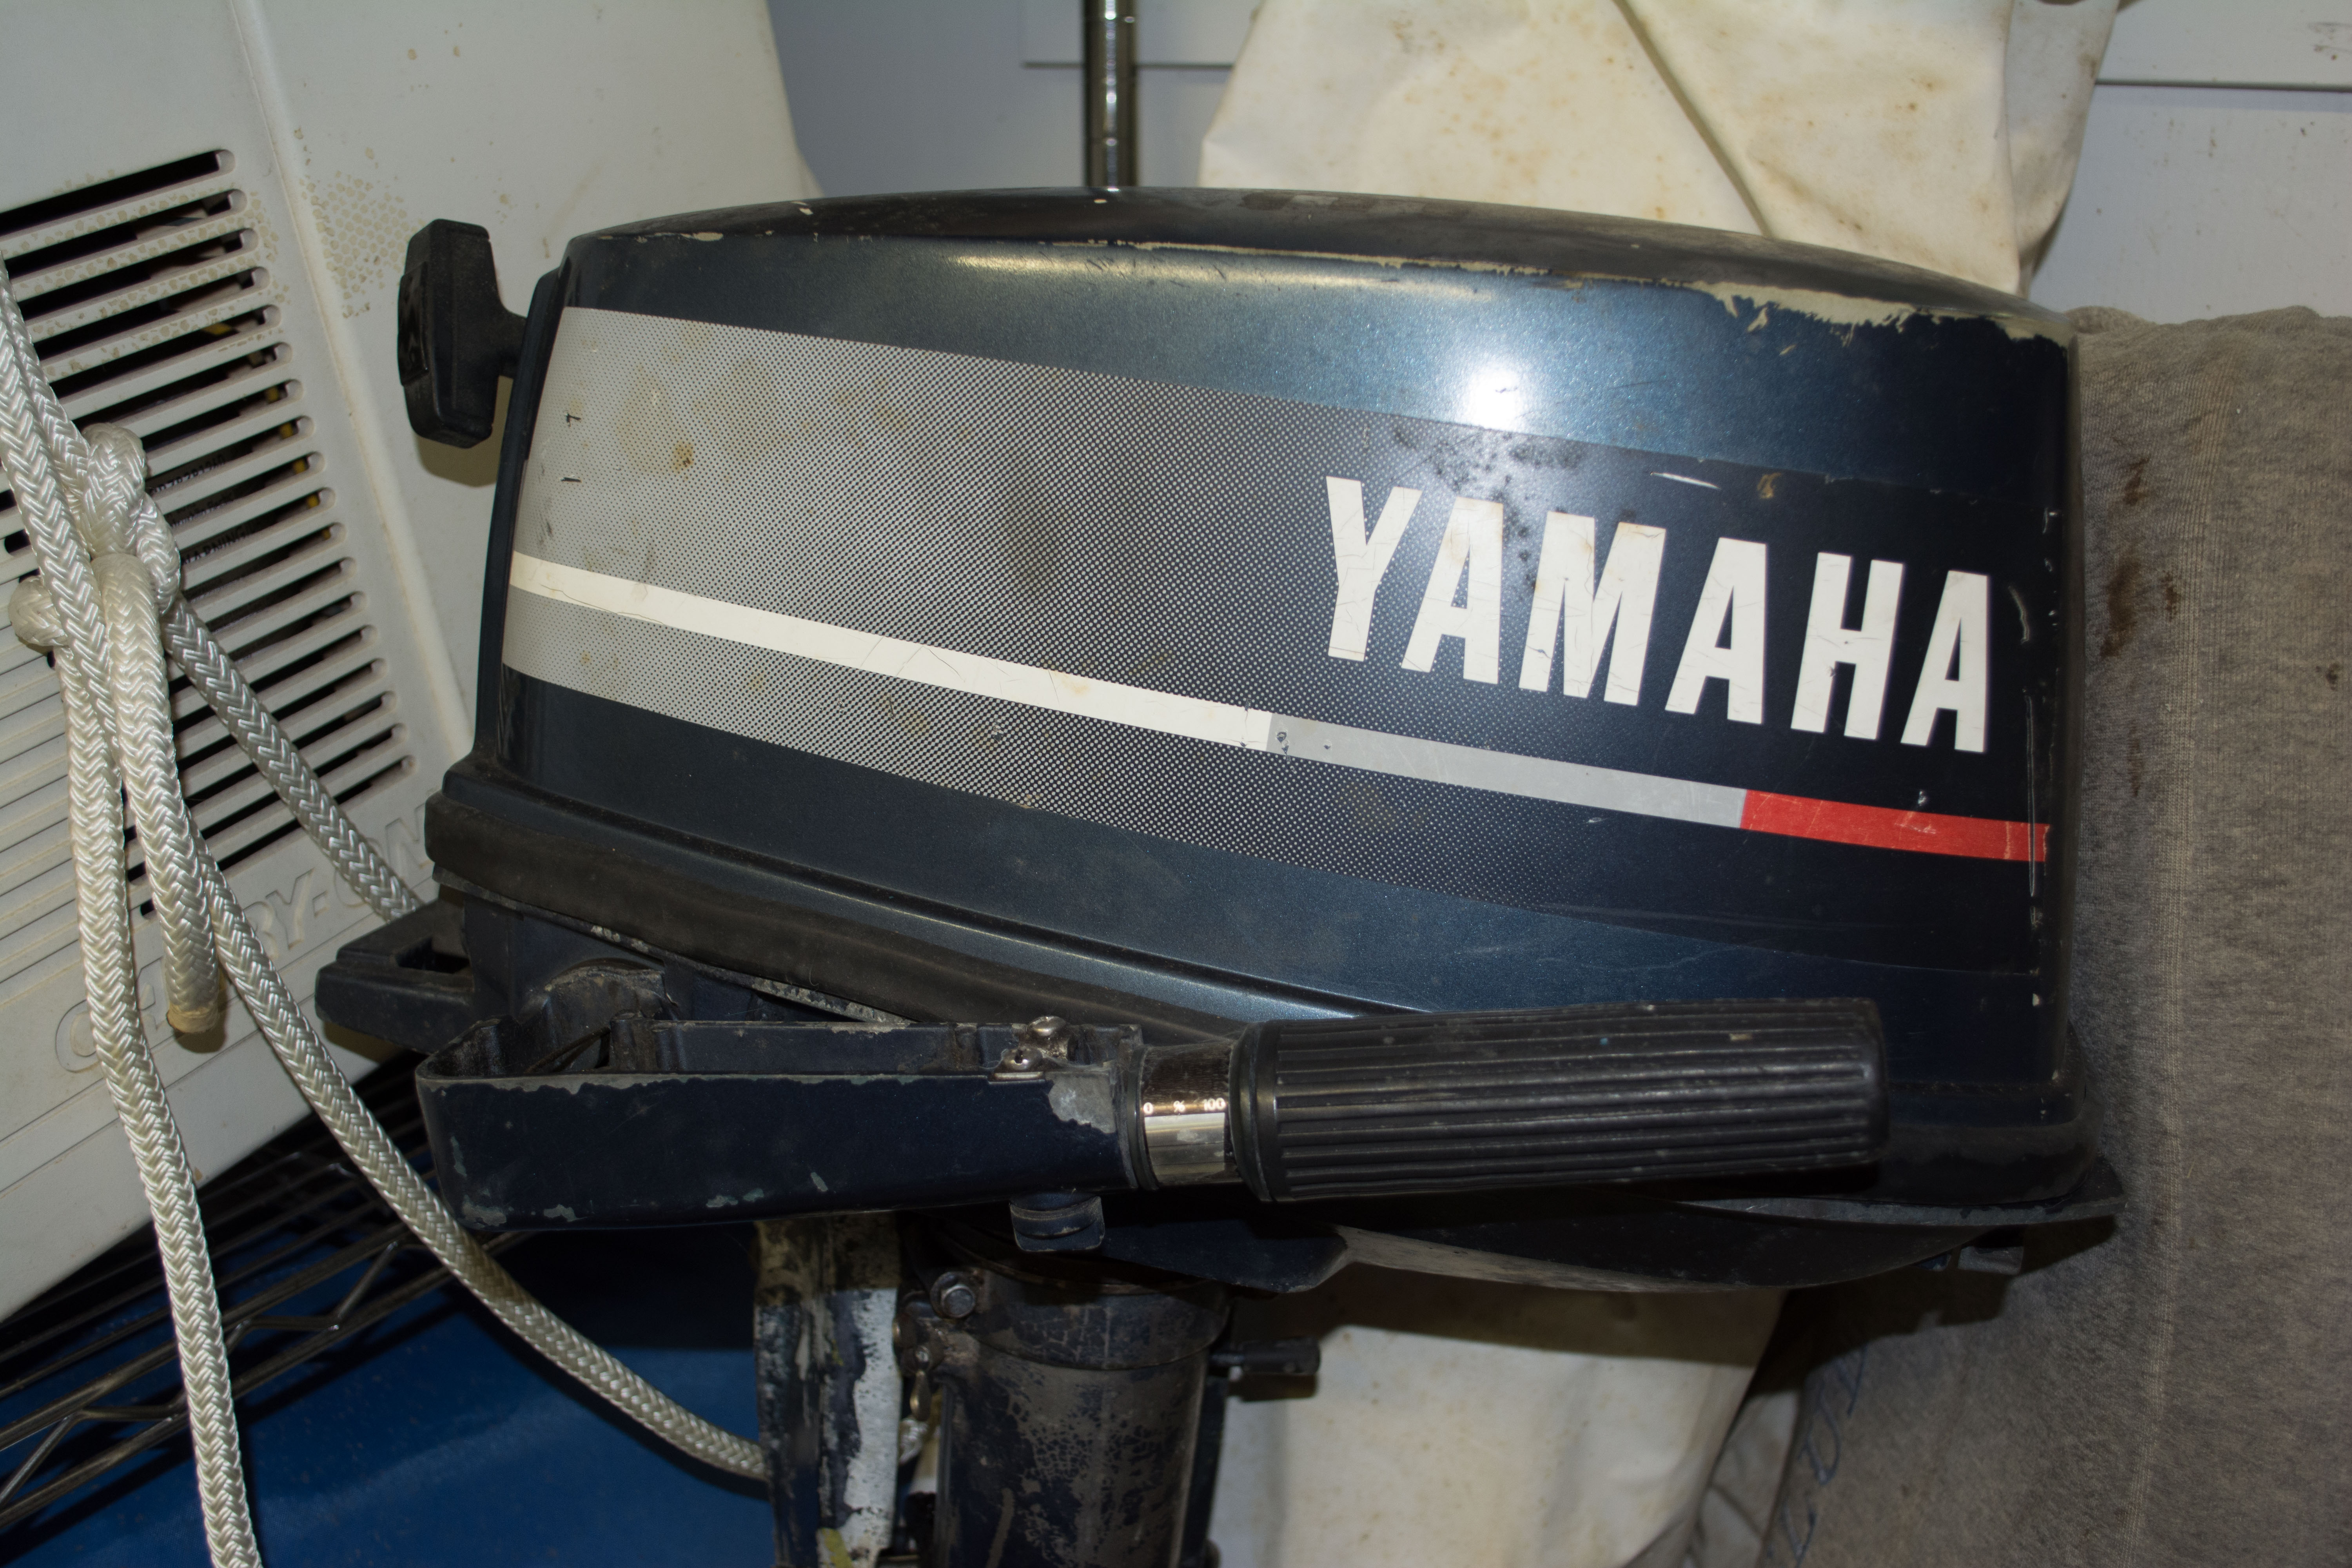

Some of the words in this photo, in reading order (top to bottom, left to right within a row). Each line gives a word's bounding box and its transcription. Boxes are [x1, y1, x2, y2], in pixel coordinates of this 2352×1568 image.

[1325, 476, 1989, 753] YAMAHA
[1143, 1102, 1154, 1114] 0
[1203, 1098, 1226, 1111] 100
